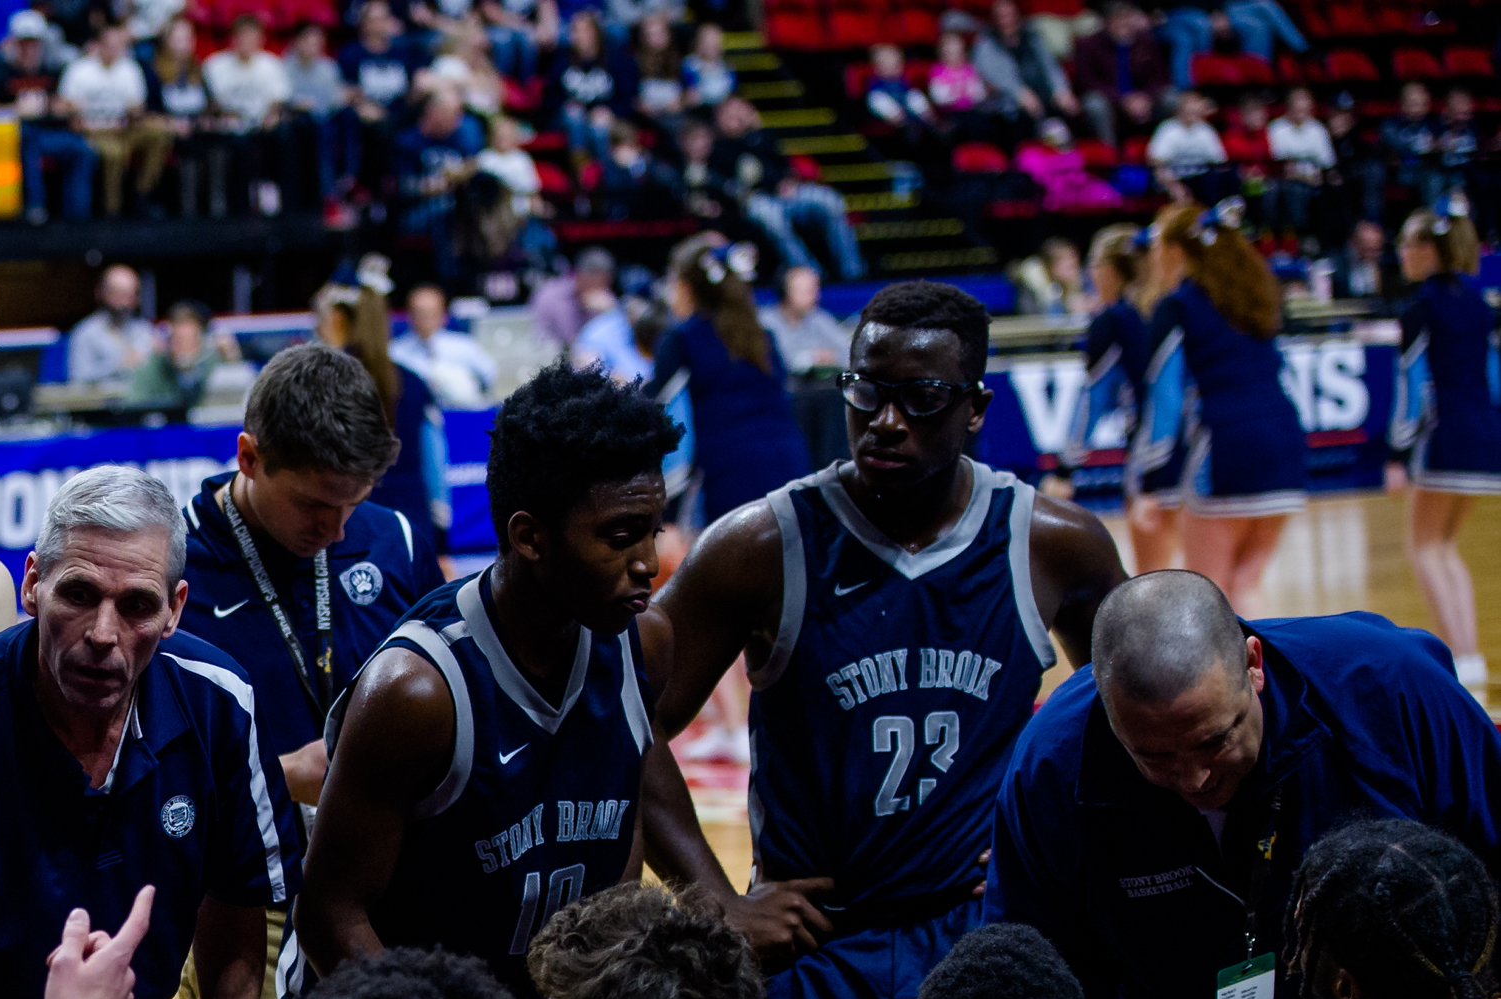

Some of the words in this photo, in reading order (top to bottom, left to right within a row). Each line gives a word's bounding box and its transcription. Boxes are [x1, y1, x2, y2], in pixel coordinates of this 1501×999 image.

[234, 524, 278, 602] CHAMPIONSHIPS
[271, 603, 293, 638] REFUEL
[826, 648, 909, 711] STONY
[919, 648, 1002, 701] BROOK
[872, 710, 960, 817] 23
[475, 802, 545, 874] STONY
[556, 799, 630, 842] BROOK
[1119, 875, 1152, 889] STONY
[1153, 864, 1195, 885] BROOK
[1126, 878, 1194, 898] BASKETBALL
